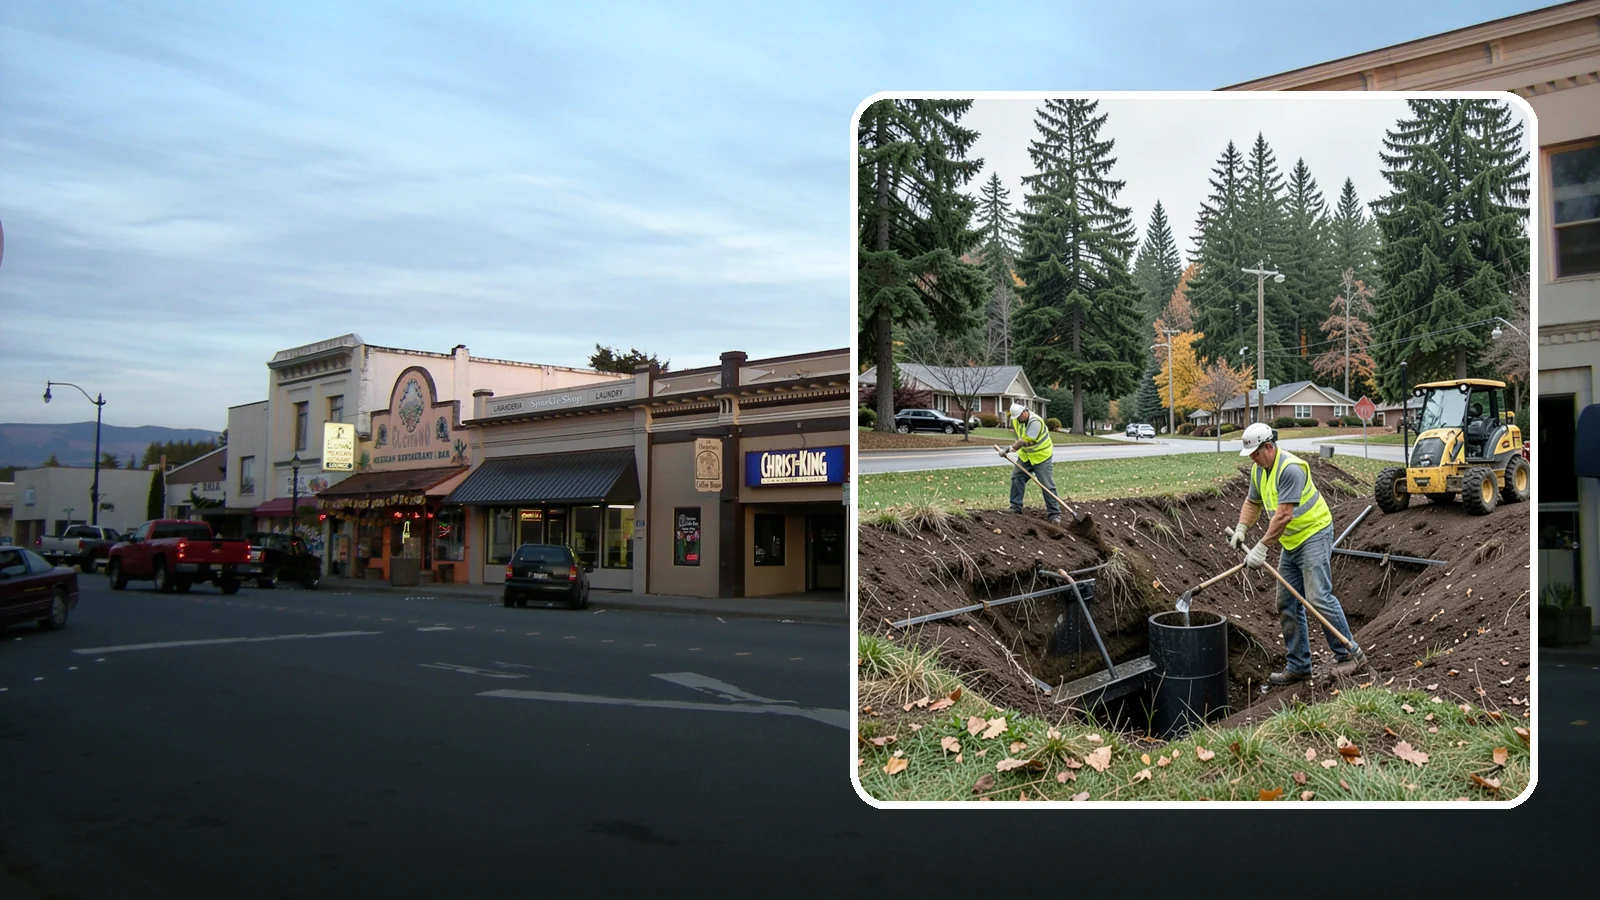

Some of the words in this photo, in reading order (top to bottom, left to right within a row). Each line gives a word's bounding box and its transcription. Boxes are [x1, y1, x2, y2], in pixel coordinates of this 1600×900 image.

[595, 388, 624, 400] LAUNDRY
[493, 402, 522, 413] LAVANDERIA
[530, 396, 560, 409] Sparkle
[561, 394, 583, 404] Shop
[373, 455, 396, 464] MEXICAN
[397, 451, 433, 463] RESTAURANT
[438, 450, 449, 459] BAR
[761, 452, 797, 478] CHRIST
[799, 450, 828, 475] KING
